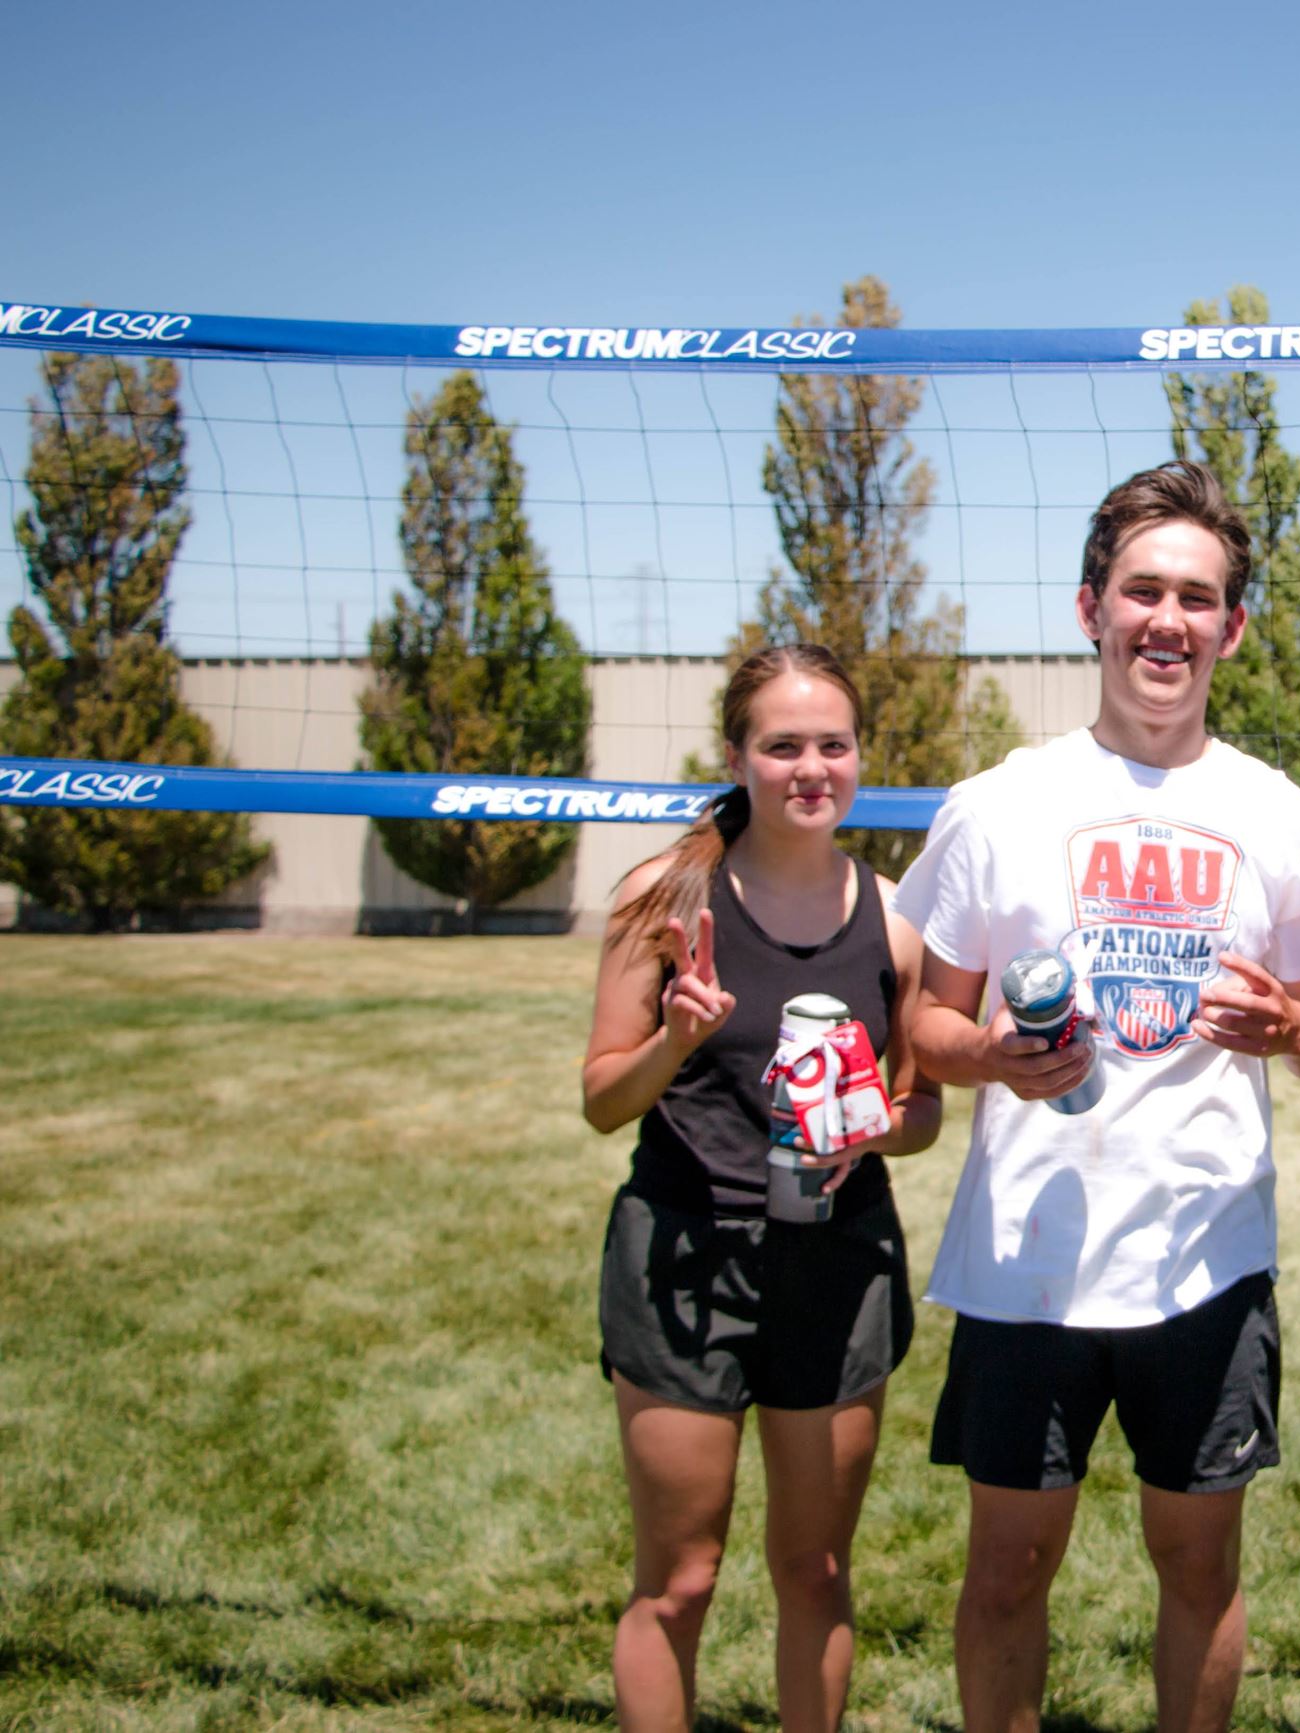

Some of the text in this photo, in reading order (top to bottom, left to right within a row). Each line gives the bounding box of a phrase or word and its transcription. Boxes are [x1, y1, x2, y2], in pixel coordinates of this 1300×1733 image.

[0, 769, 165, 802] CLASSIC
[1137, 824, 1173, 840] 1888
[1081, 840, 1224, 909] AAU
[1135, 908, 1185, 923] ATHLETIC
[1188, 912, 1219, 925] UNION
[1092, 955, 1210, 977] HAMPIONSHIP
